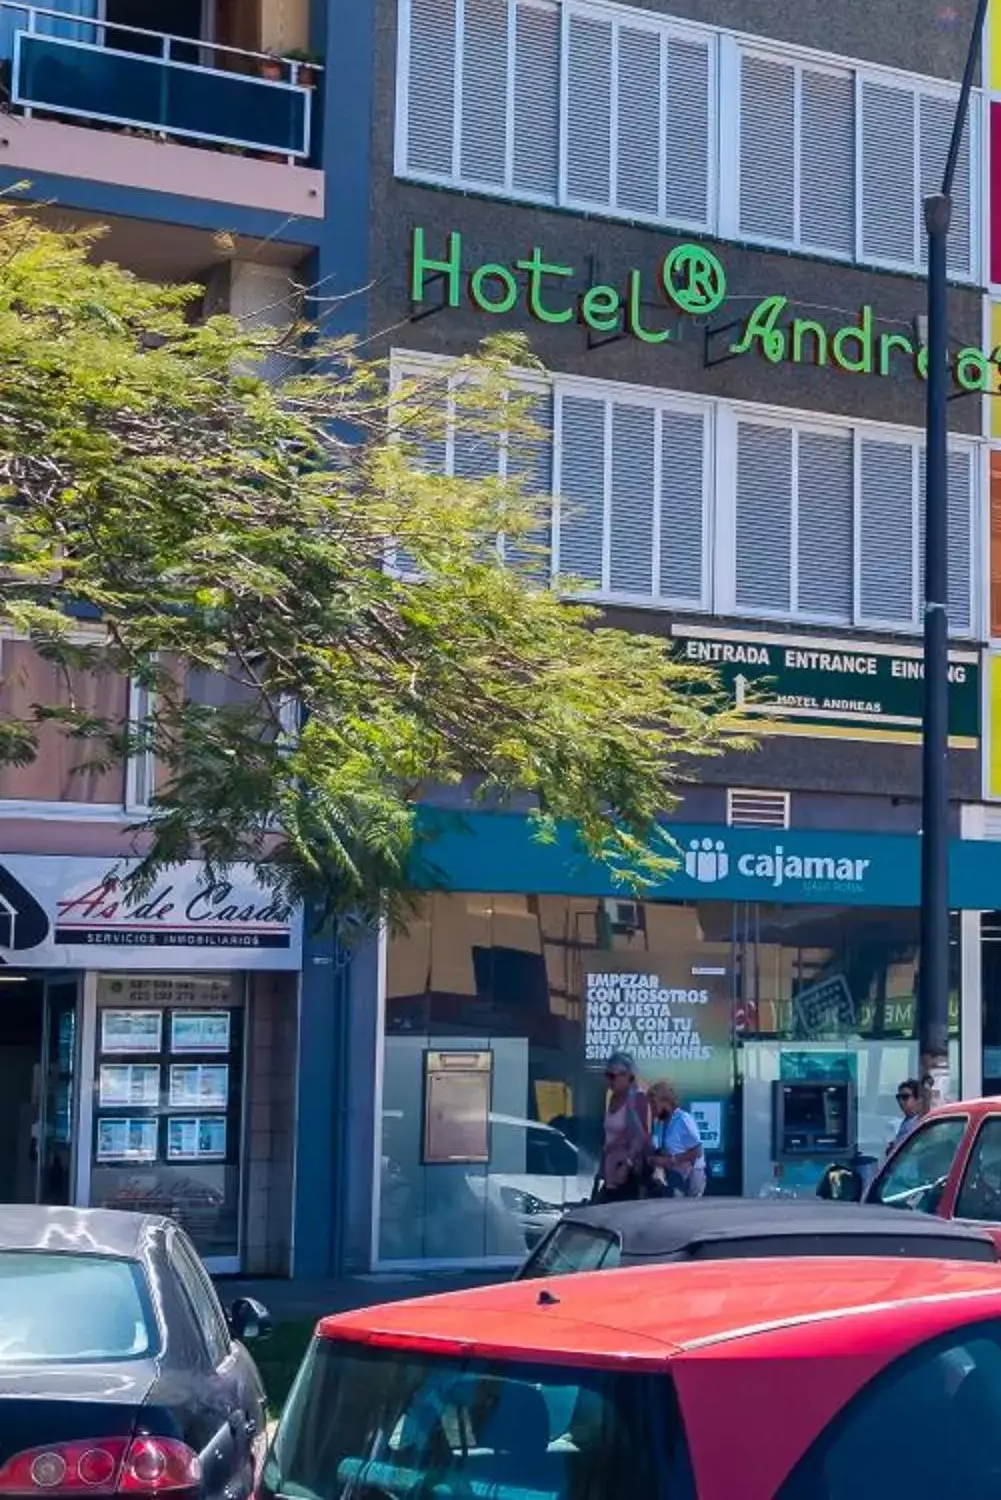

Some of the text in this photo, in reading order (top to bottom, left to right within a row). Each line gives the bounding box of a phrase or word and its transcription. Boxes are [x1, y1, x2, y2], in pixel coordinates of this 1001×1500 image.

[410, 226, 673, 344] Hotel
[686, 640, 770, 666] ENTRADA
[784, 651, 878, 675] ENTRANCE
[777, 694, 882, 714] HOTEL ANDREAS
[737, 845, 871, 888] cajamar
[124, 885, 174, 920] de
[185, 884, 294, 924] Casas
[87, 933, 260, 946] SERVICIOS INMOBILIARIOS
[587, 973, 659, 989] EMPEZAR
[587, 988, 709, 1004] CON NOSOTROS
[587, 1002, 671, 1016] NO CUESTA
[587, 1017, 692, 1031] NADA CON TU
[586, 1031, 701, 1046] NUEVA CUENTA
[585, 1046, 613, 1060] SIN
